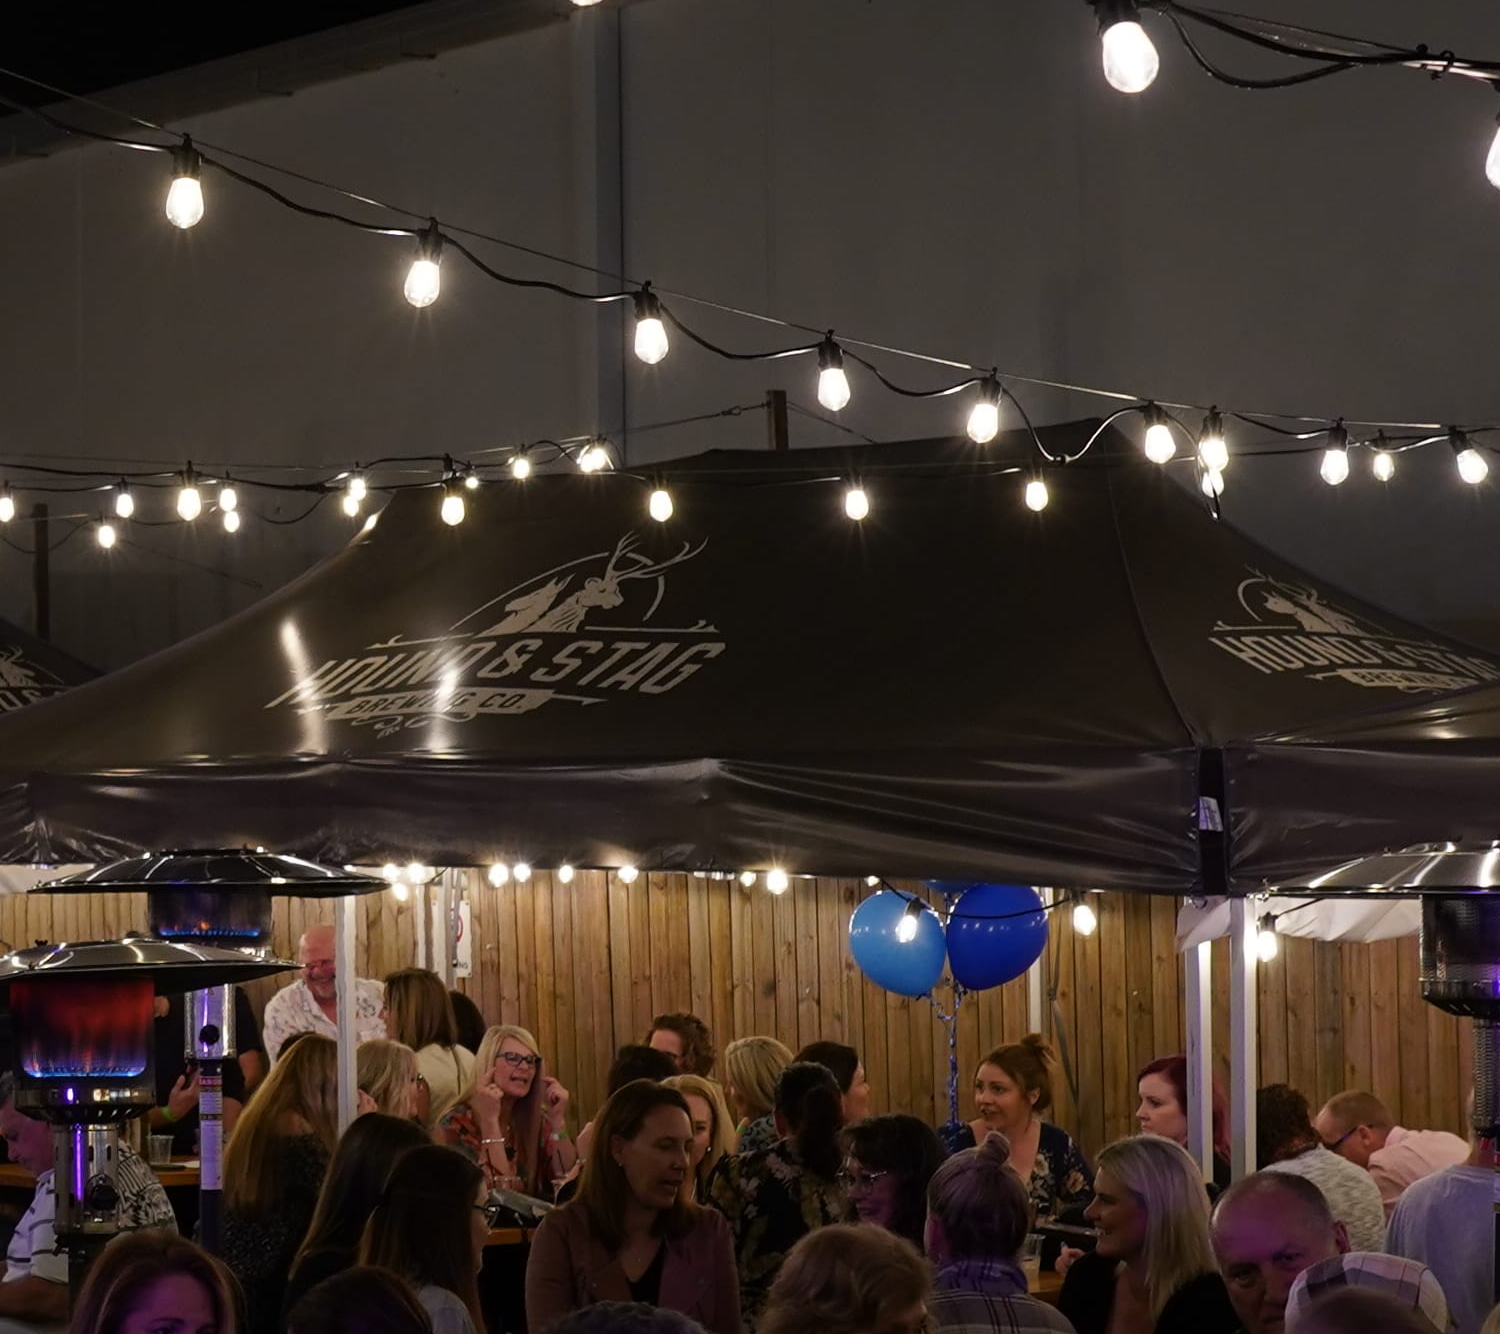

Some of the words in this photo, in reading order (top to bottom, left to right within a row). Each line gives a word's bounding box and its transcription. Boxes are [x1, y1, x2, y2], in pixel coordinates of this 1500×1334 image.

[263, 641, 498, 709] HOUND
[476, 638, 544, 679] &
[529, 640, 727, 695] STAG
[1208, 635, 1382, 674] HOUND
[1359, 639, 1418, 667] &
